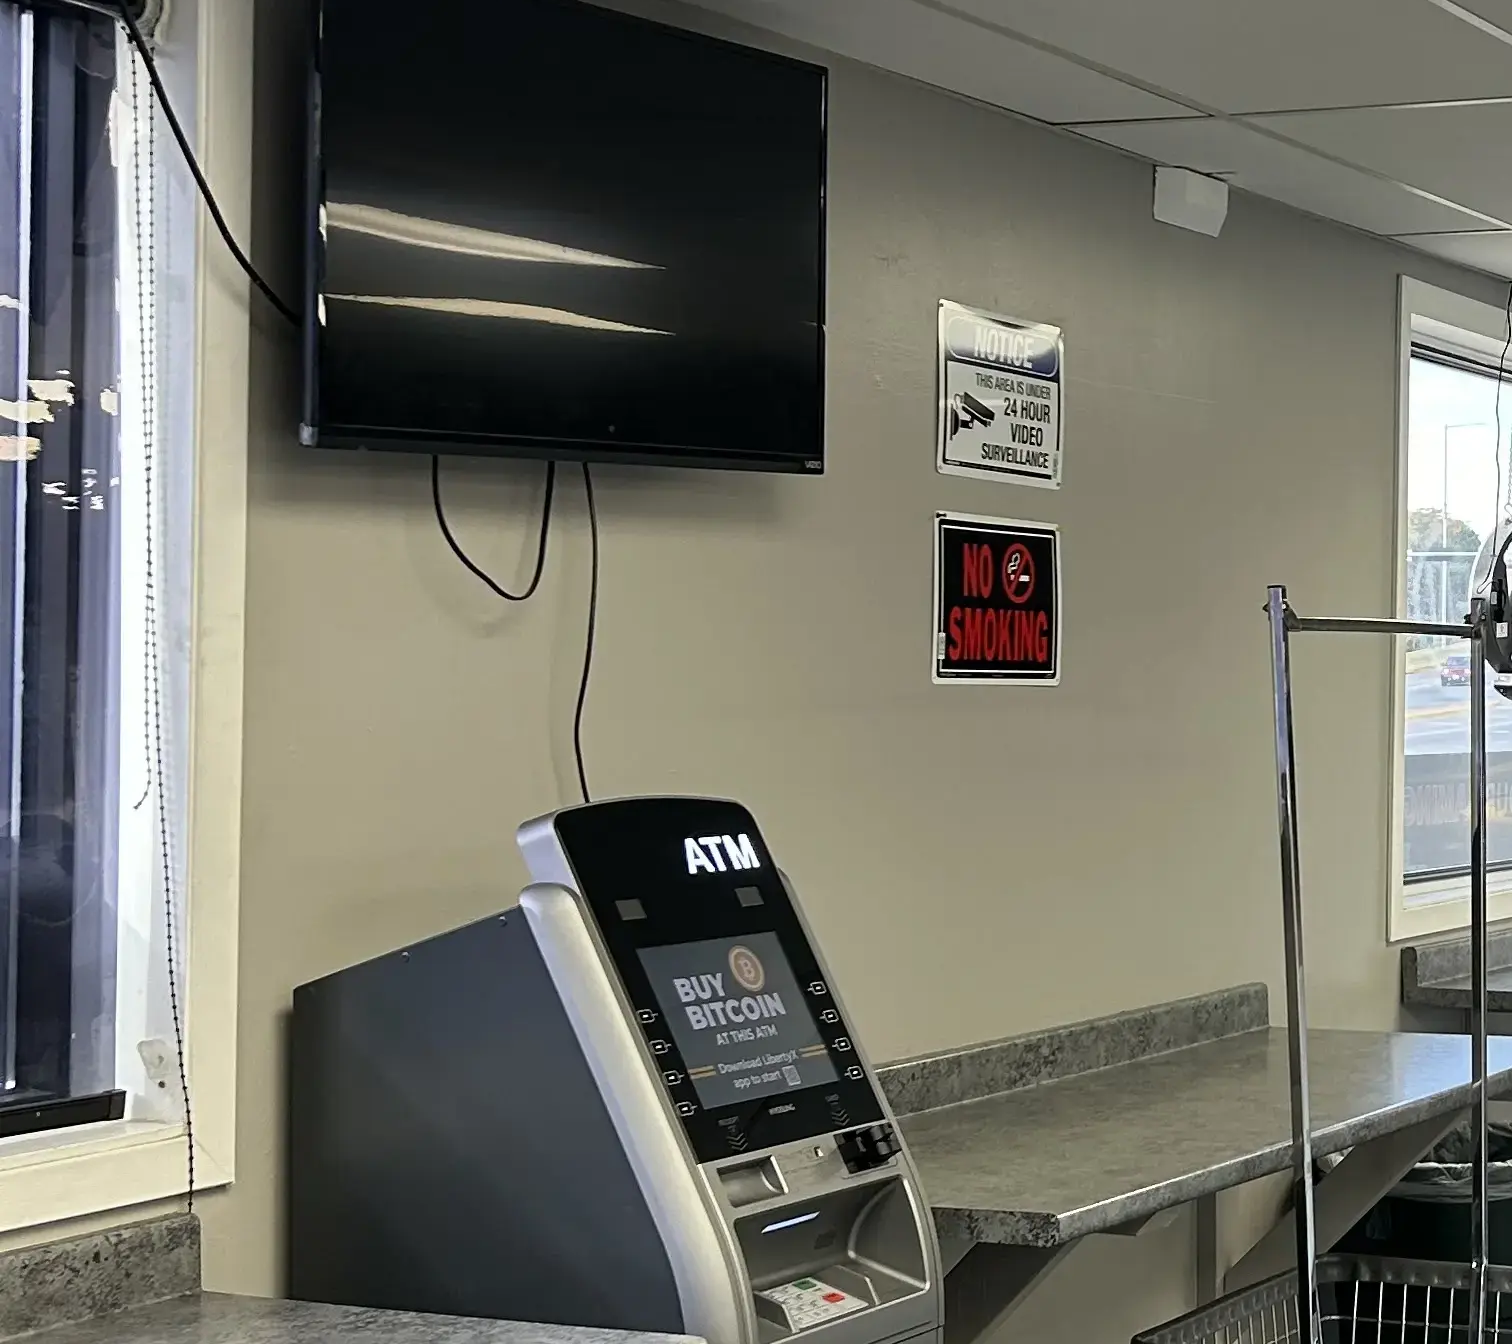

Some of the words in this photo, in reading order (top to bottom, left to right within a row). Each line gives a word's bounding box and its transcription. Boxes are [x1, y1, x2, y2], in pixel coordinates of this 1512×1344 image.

[974, 325, 1034, 369] NOTICE
[976, 372, 993, 389] THIS
[995, 376, 1015, 393] AREA
[1017, 380, 1024, 395] IS
[1026, 382, 1051, 400] UNDER
[1004, 397, 1018, 417] 24
[1021, 400, 1051, 424] HOUR
[1011, 422, 1043, 447] VIDEO
[981, 443, 1049, 468] SURVEILLANCE
[964, 543, 993, 598] NO
[949, 606, 1048, 662] SMOKING
[684, 833, 760, 874] ATM
[673, 973, 725, 1003] BUY
[685, 992, 786, 1030] BITCOIN
[716, 1031, 730, 1045] AT
[730, 1028, 755, 1043] THIS
[756, 1024, 778, 1039] ATM
[718, 1056, 762, 1074] Download
[762, 1049, 799, 1065] LibertyX
[732, 1077, 751, 1089] app
[750, 1075, 761, 1084] to
[761, 1070, 782, 1083] start
